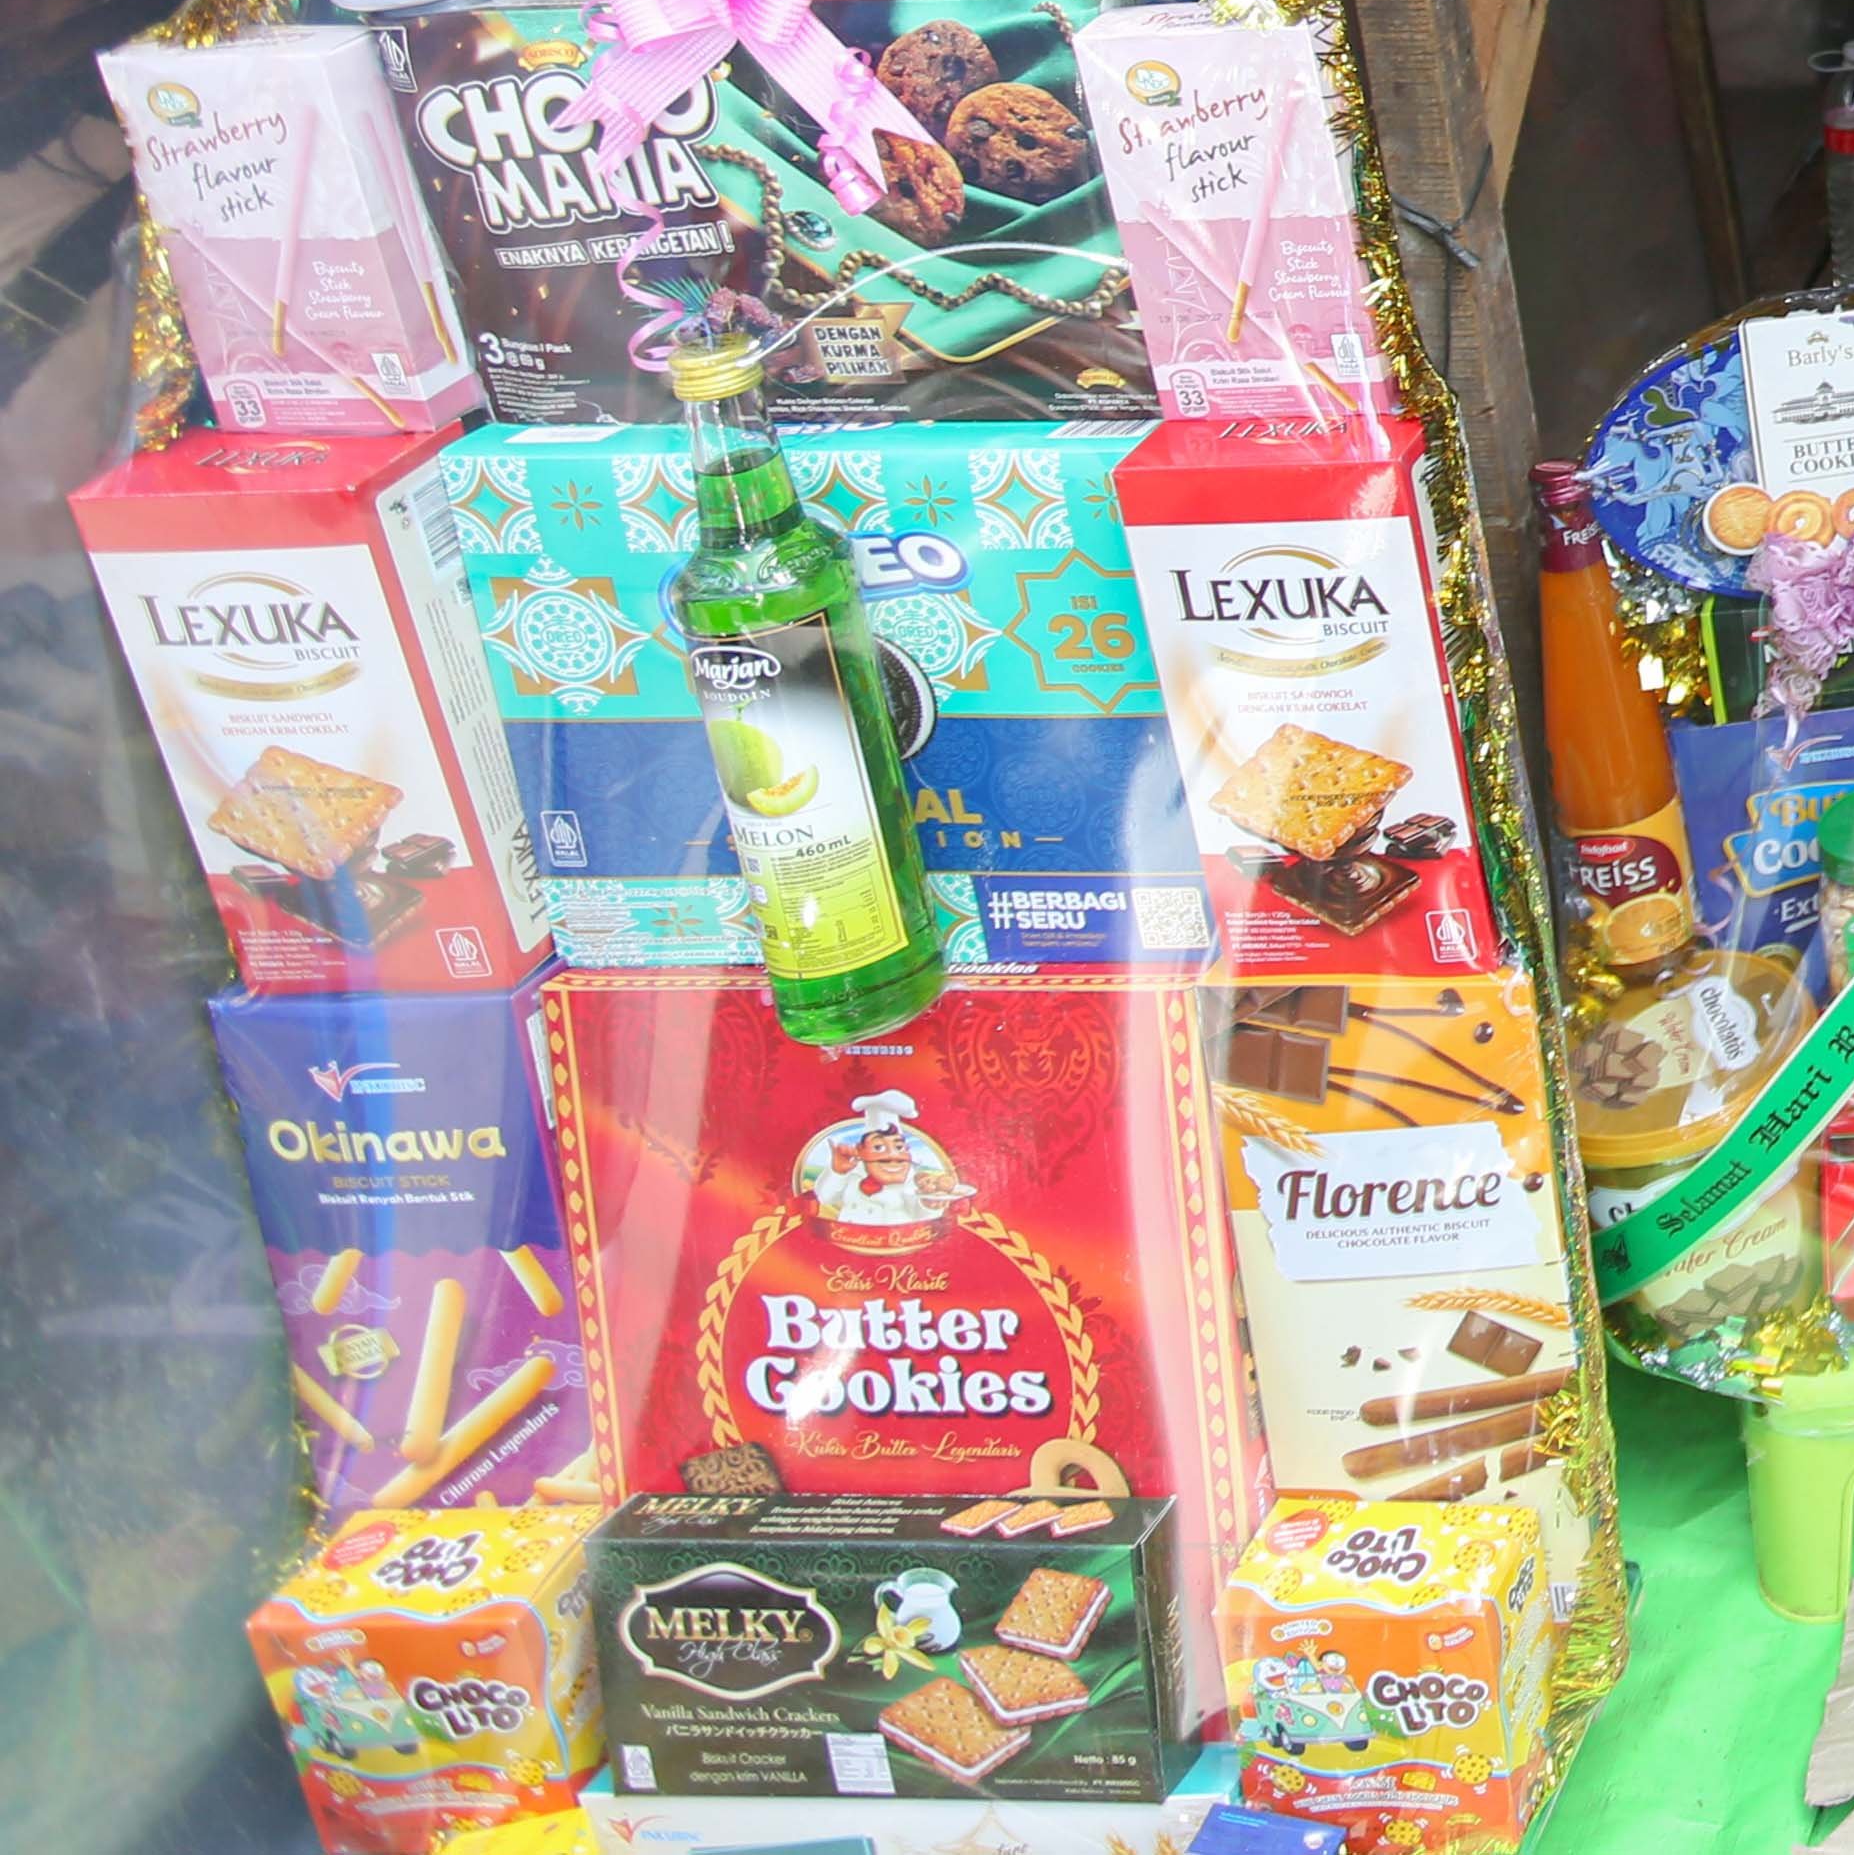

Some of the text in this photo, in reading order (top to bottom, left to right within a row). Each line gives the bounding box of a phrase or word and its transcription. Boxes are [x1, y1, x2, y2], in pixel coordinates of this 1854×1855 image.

[418, 72, 718, 175] CHOO
[1117, 83, 1270, 157] Stawberry
[146, 110, 288, 173] Strawberry
[1165, 131, 1258, 184] flavour
[192, 155, 278, 201] flavour
[481, 138, 718, 231] MANIA
[1189, 163, 1249, 205] stick
[219, 184, 274, 223] stick
[813, 325, 883, 343] DENGAN
[820, 343, 881, 360] KURMA
[1786, 340, 1854, 370] Barly's
[1169, 568, 1389, 624] LEXUKA
[140, 592, 361, 650] LEXUKA
[1048, 613, 1136, 660] 26
[1322, 619, 1390, 637] BISCUIT
[294, 645, 362, 663] BISCUIT
[691, 648, 782, 690] Marjan
[733, 824, 815, 847] MELON
[795, 841, 827, 858] 460
[1580, 840, 1629, 855] Indofood
[1016, 909, 1088, 931] SERU
[268, 1119, 508, 1164] Okinawa
[1656, 1158, 1754, 1239] Selamat
[1749, 1063, 1833, 1153] Hari
[1276, 1167, 1503, 1224] Florence
[760, 1293, 1020, 1352] Butter
[744, 1354, 1053, 1417] Cookies
[644, 1605, 807, 1645] MELKY
[411, 1680, 530, 1713] CHOCO
[1369, 1675, 1488, 1710] CHOCO
